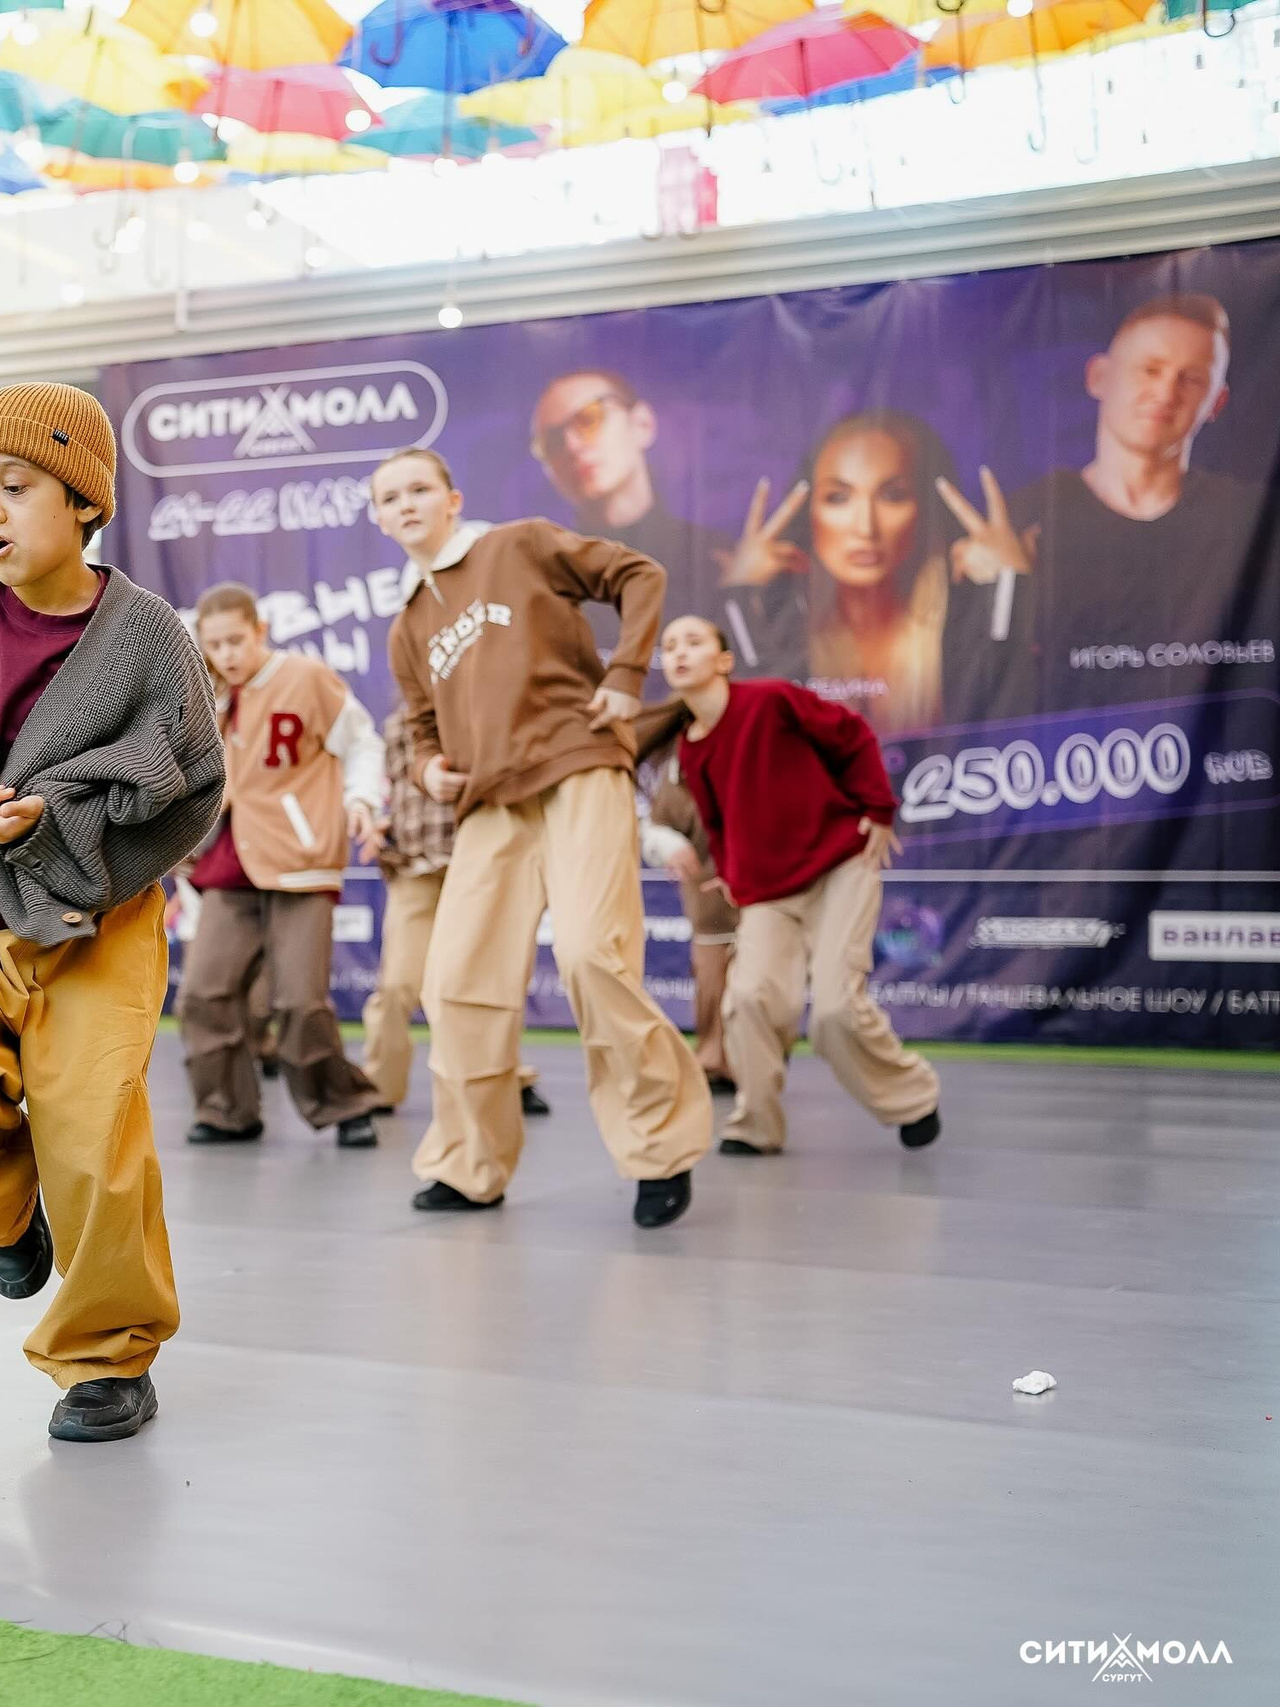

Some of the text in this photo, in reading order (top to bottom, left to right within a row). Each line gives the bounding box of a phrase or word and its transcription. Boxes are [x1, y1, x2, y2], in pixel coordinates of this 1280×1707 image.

[148, 381, 418, 441] СИТИ МОЛЛ
[1070, 639, 1275, 669] ИГОРЬ СОЛОВЬЕВ
[263, 713, 304, 768] R
[899, 722, 1191, 823] 250.000
[1144, 987, 1206, 1014] ШОУ
